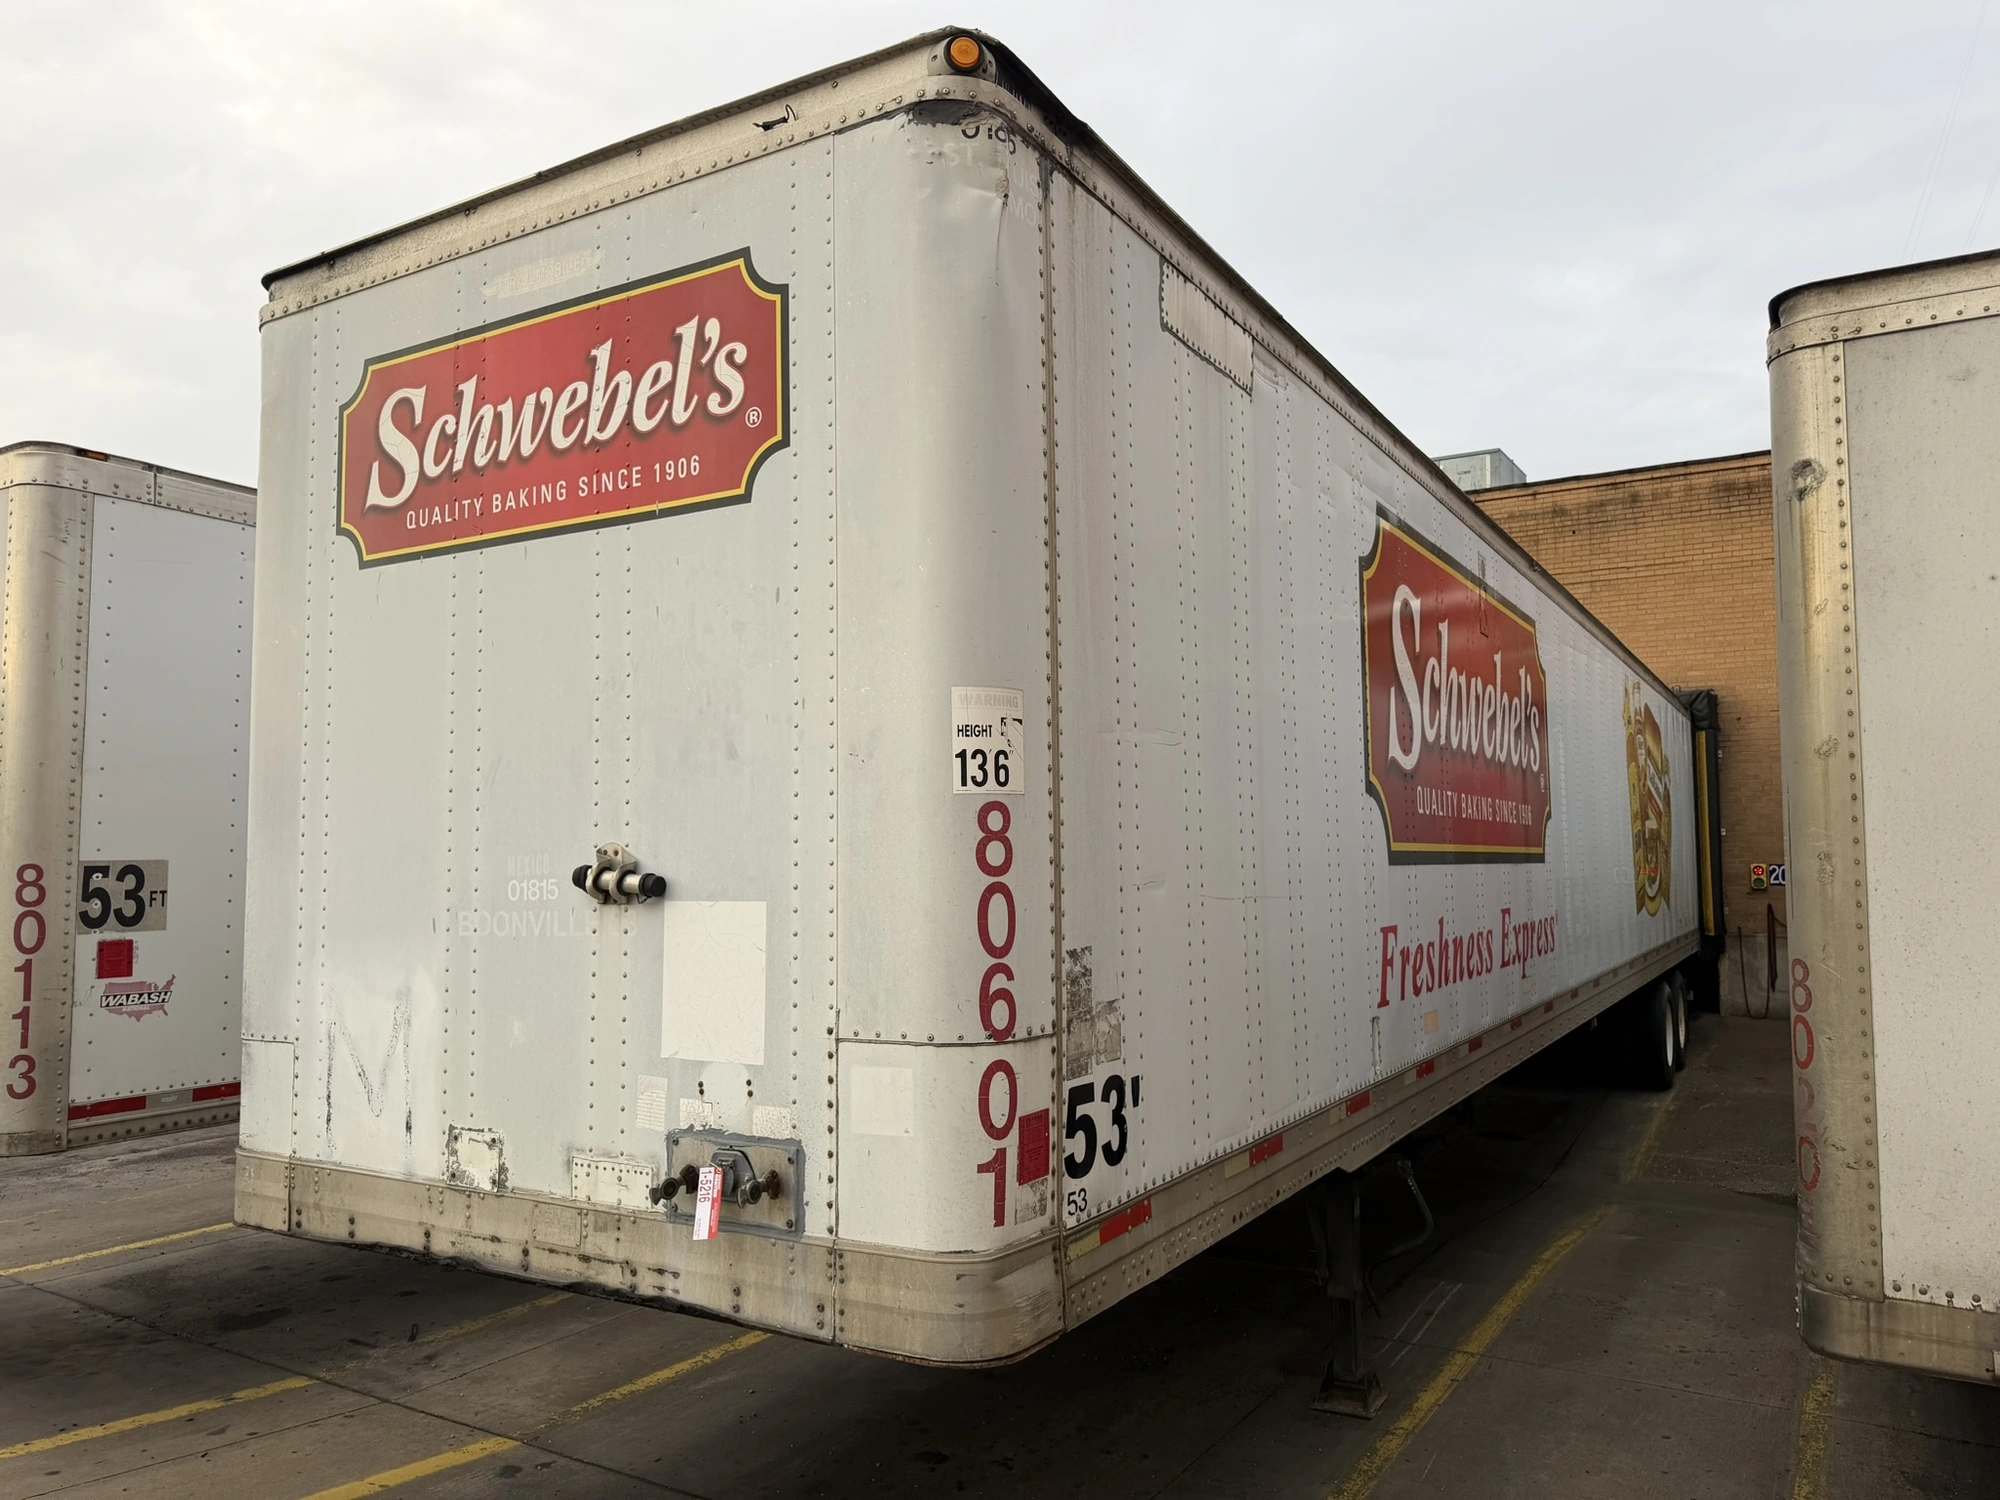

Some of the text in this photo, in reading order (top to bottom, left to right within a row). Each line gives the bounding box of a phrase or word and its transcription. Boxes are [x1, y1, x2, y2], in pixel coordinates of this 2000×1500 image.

[364, 315, 748, 512] Schwebel's
[406, 455, 700, 529] QUALITY BAKING SINCE 1906
[959, 693, 1019, 709] WARNING
[1388, 584, 1540, 772] Schwebel's
[957, 724, 992, 738] HEIGHT
[1417, 785, 1458, 818] QUALITY
[1462, 794, 1493, 821] BAKING
[1496, 798, 1517, 824] SINCE
[78, 864, 167, 930] 53 FT
[508, 879, 558, 901] 01815
[6, 863, 47, 1101] 80113
[1377, 907, 1556, 1009] Freshness Express
[102, 991, 171, 1008] WABASH
[976, 800, 1018, 1228] 80601
[698, 1169, 713, 1204] 1-5216
[1066, 1187, 1088, 1216] 53
